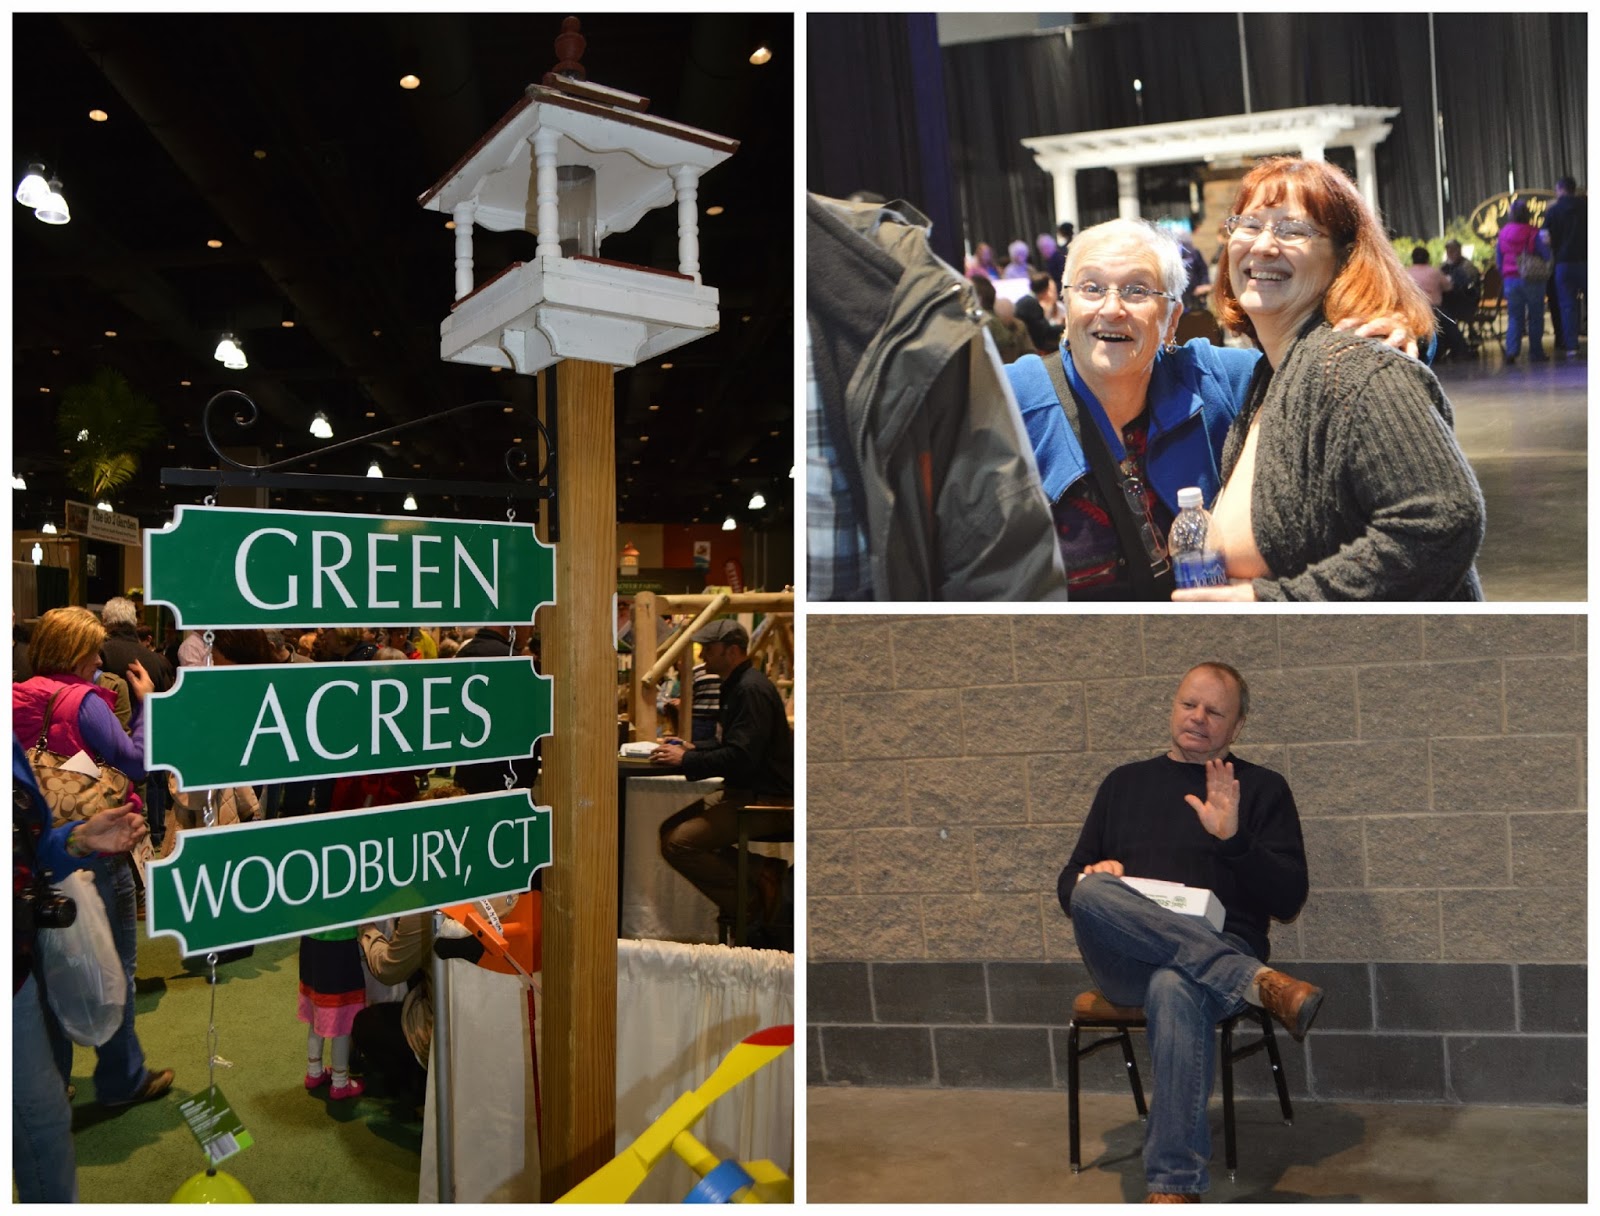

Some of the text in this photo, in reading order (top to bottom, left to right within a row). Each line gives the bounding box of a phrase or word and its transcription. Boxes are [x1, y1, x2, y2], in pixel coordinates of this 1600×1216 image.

[234, 527, 500, 610] GREEN
[239, 674, 493, 767] ACRES
[171, 815, 537, 923] WOODBURY, CT
